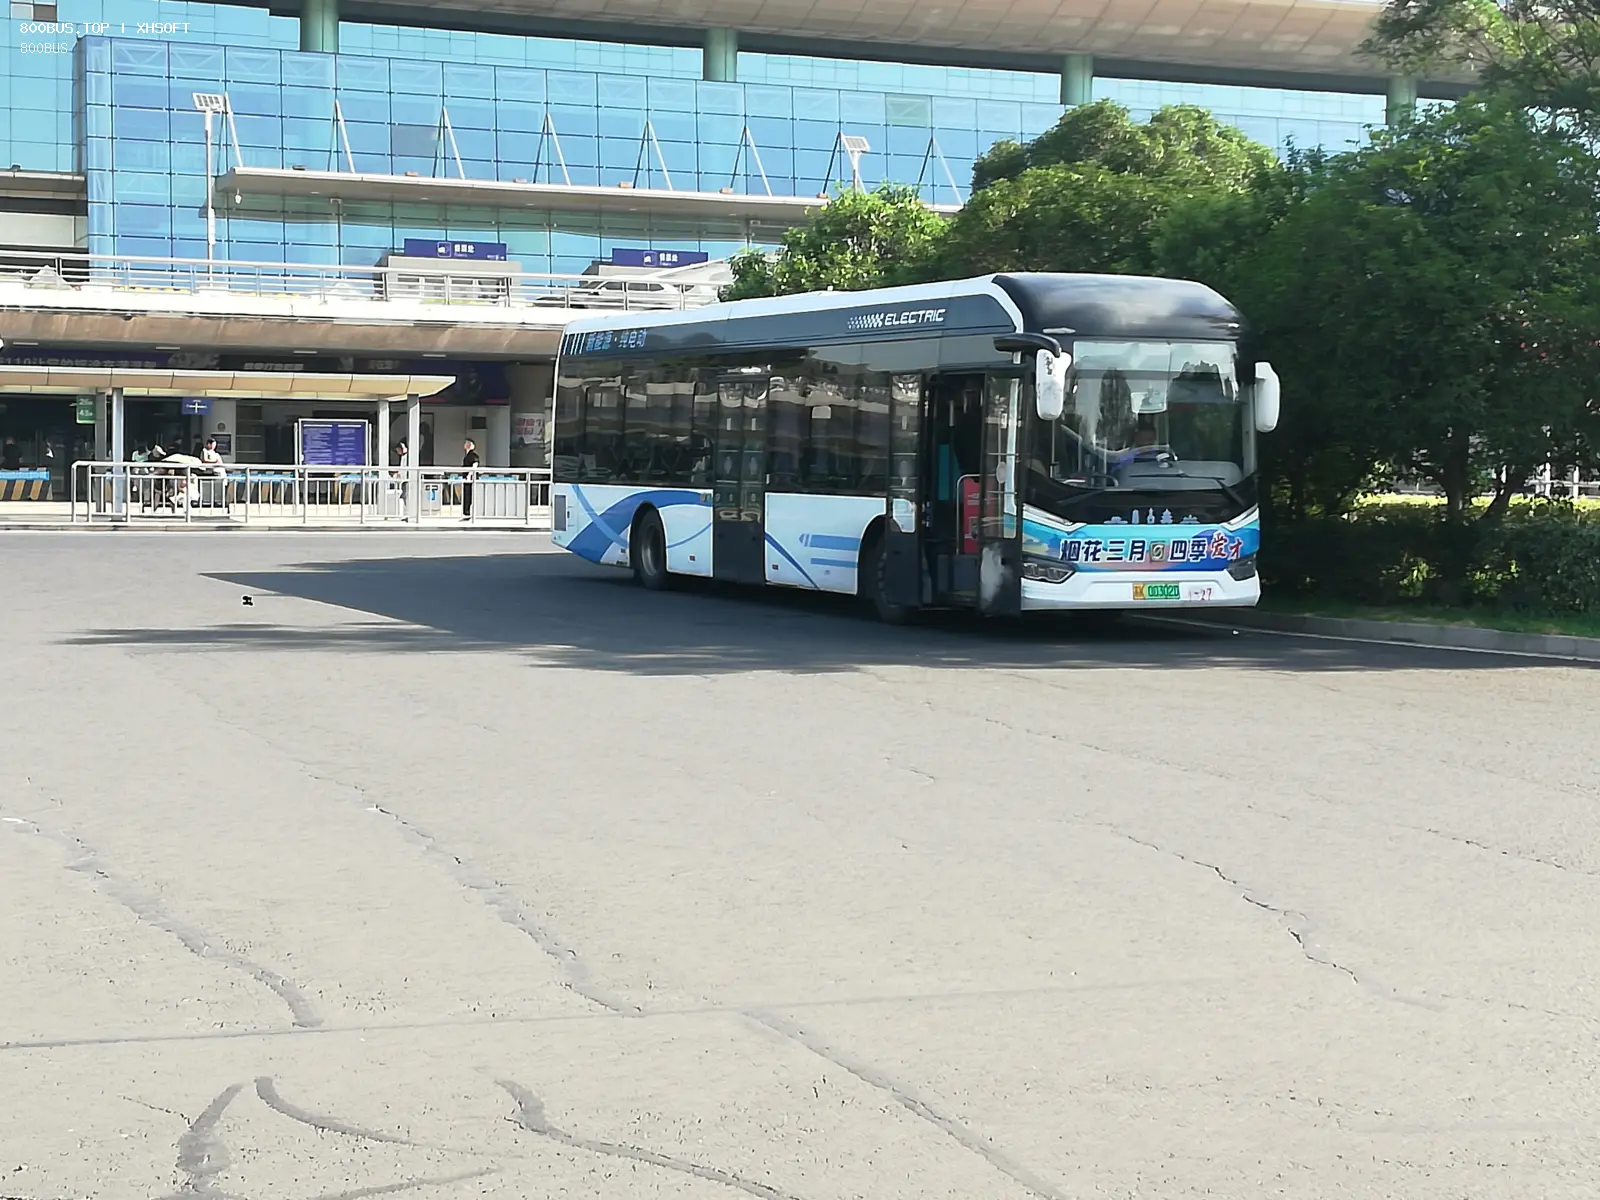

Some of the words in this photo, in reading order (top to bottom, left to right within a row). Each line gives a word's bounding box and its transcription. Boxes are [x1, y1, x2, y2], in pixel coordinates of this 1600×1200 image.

[884, 308, 947, 326] ELECTRIC
[1059, 538, 1146, 563] 烟花三月
